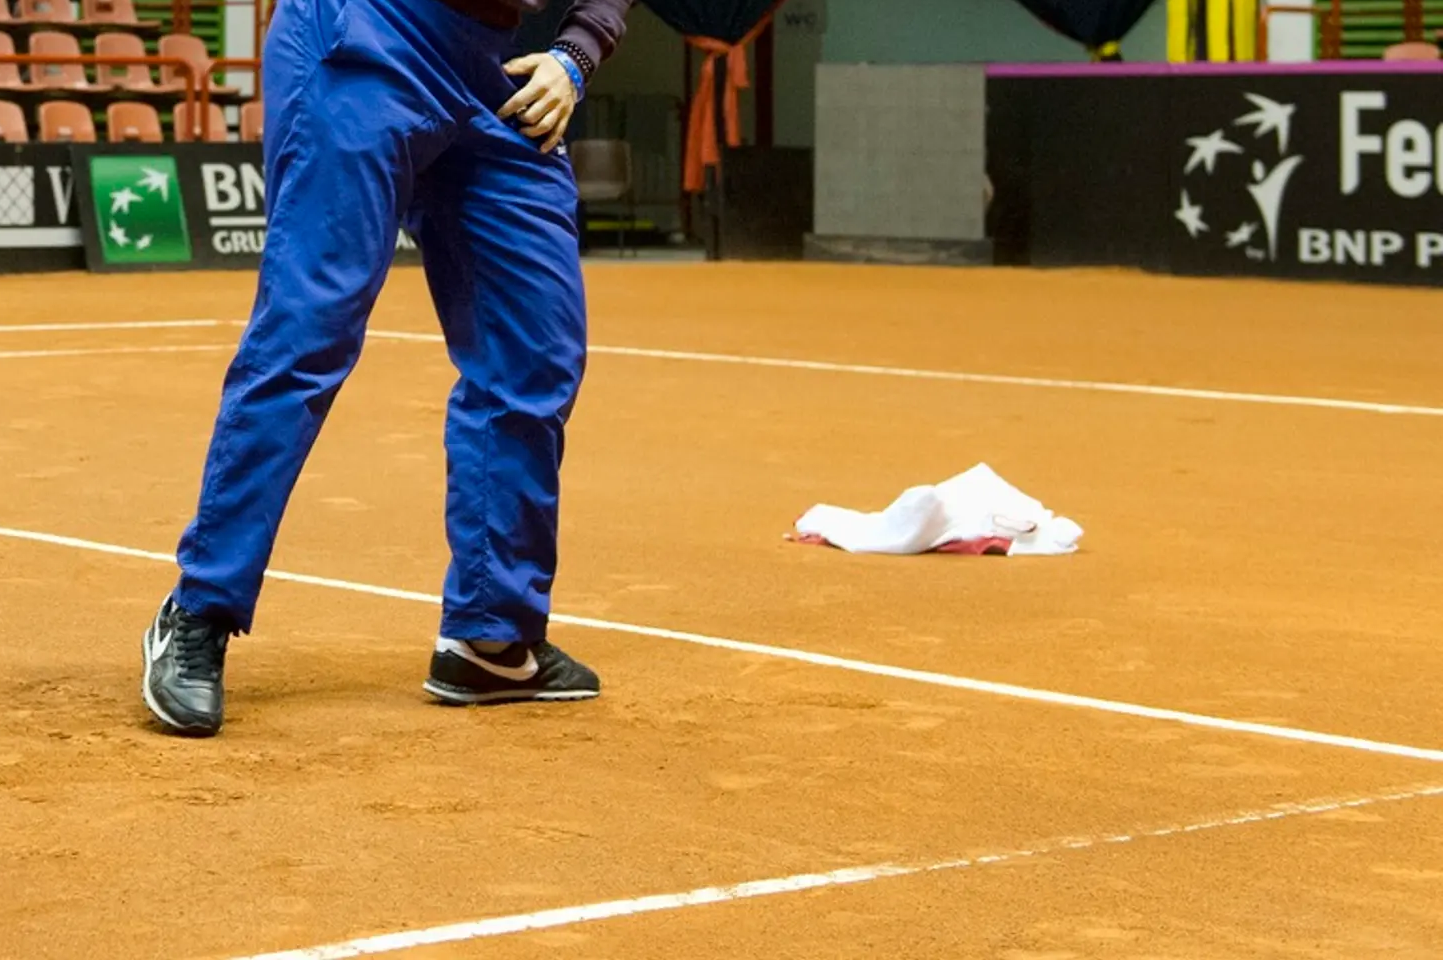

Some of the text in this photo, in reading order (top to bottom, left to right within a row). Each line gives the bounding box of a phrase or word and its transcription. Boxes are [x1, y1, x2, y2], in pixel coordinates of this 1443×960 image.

[1339, 90, 1443, 198] Fe
[200, 162, 266, 212] BN
[212, 229, 266, 253] GRU
[1298, 227, 1404, 266] BNP
